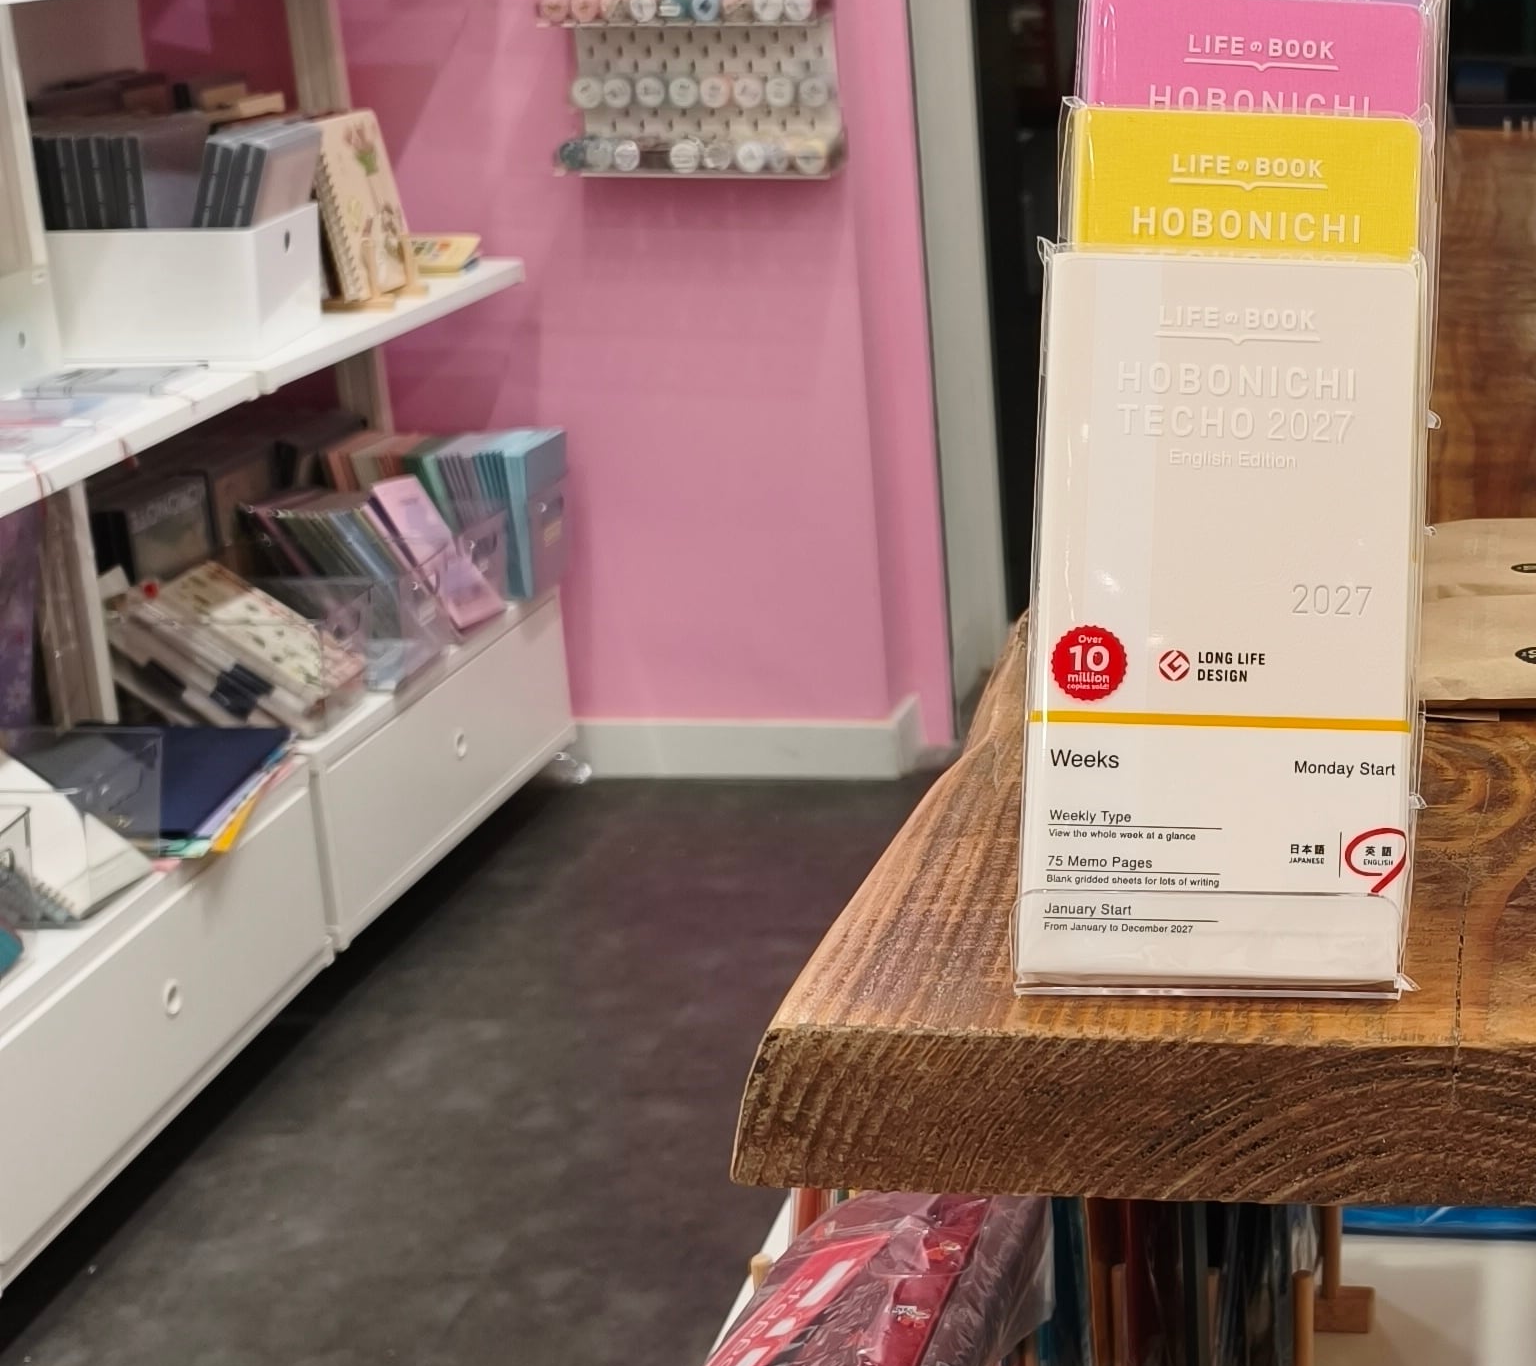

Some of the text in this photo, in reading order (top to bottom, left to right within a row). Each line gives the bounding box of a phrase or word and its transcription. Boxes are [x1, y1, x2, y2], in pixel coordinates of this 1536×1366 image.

[1189, 34, 1243, 55] LIFE
[1268, 38, 1335, 60] BOOK
[1149, 84, 1370, 116] HOBONICHI
[1173, 154, 1230, 175] LIFE
[1255, 156, 1323, 178] BOOK
[1132, 205, 1361, 244] HOBONICHI
[1159, 305, 1219, 328] LIFE
[1244, 308, 1317, 331] BOOK
[1117, 361, 1357, 401] HOBONICHI
[1116, 404, 1355, 442] TECHO 2027
[1169, 449, 1297, 469] English Edition
[1291, 585, 1373, 616] 2027
[1078, 635, 1103, 643] Over
[1069, 645, 1110, 671] 10
[1198, 651, 1265, 667] LONG LIFE
[1067, 672, 1110, 683] million
[1197, 669, 1248, 683] DESIGN
[1050, 749, 1119, 769] Weeks
[1294, 760, 1395, 778] Monday Start
[1049, 809, 1132, 825] Weekly Type
[1290, 844, 1325, 856] 日本語
[1047, 855, 1153, 871] 75 Memo Pages
[1044, 903, 1132, 917] January Start
